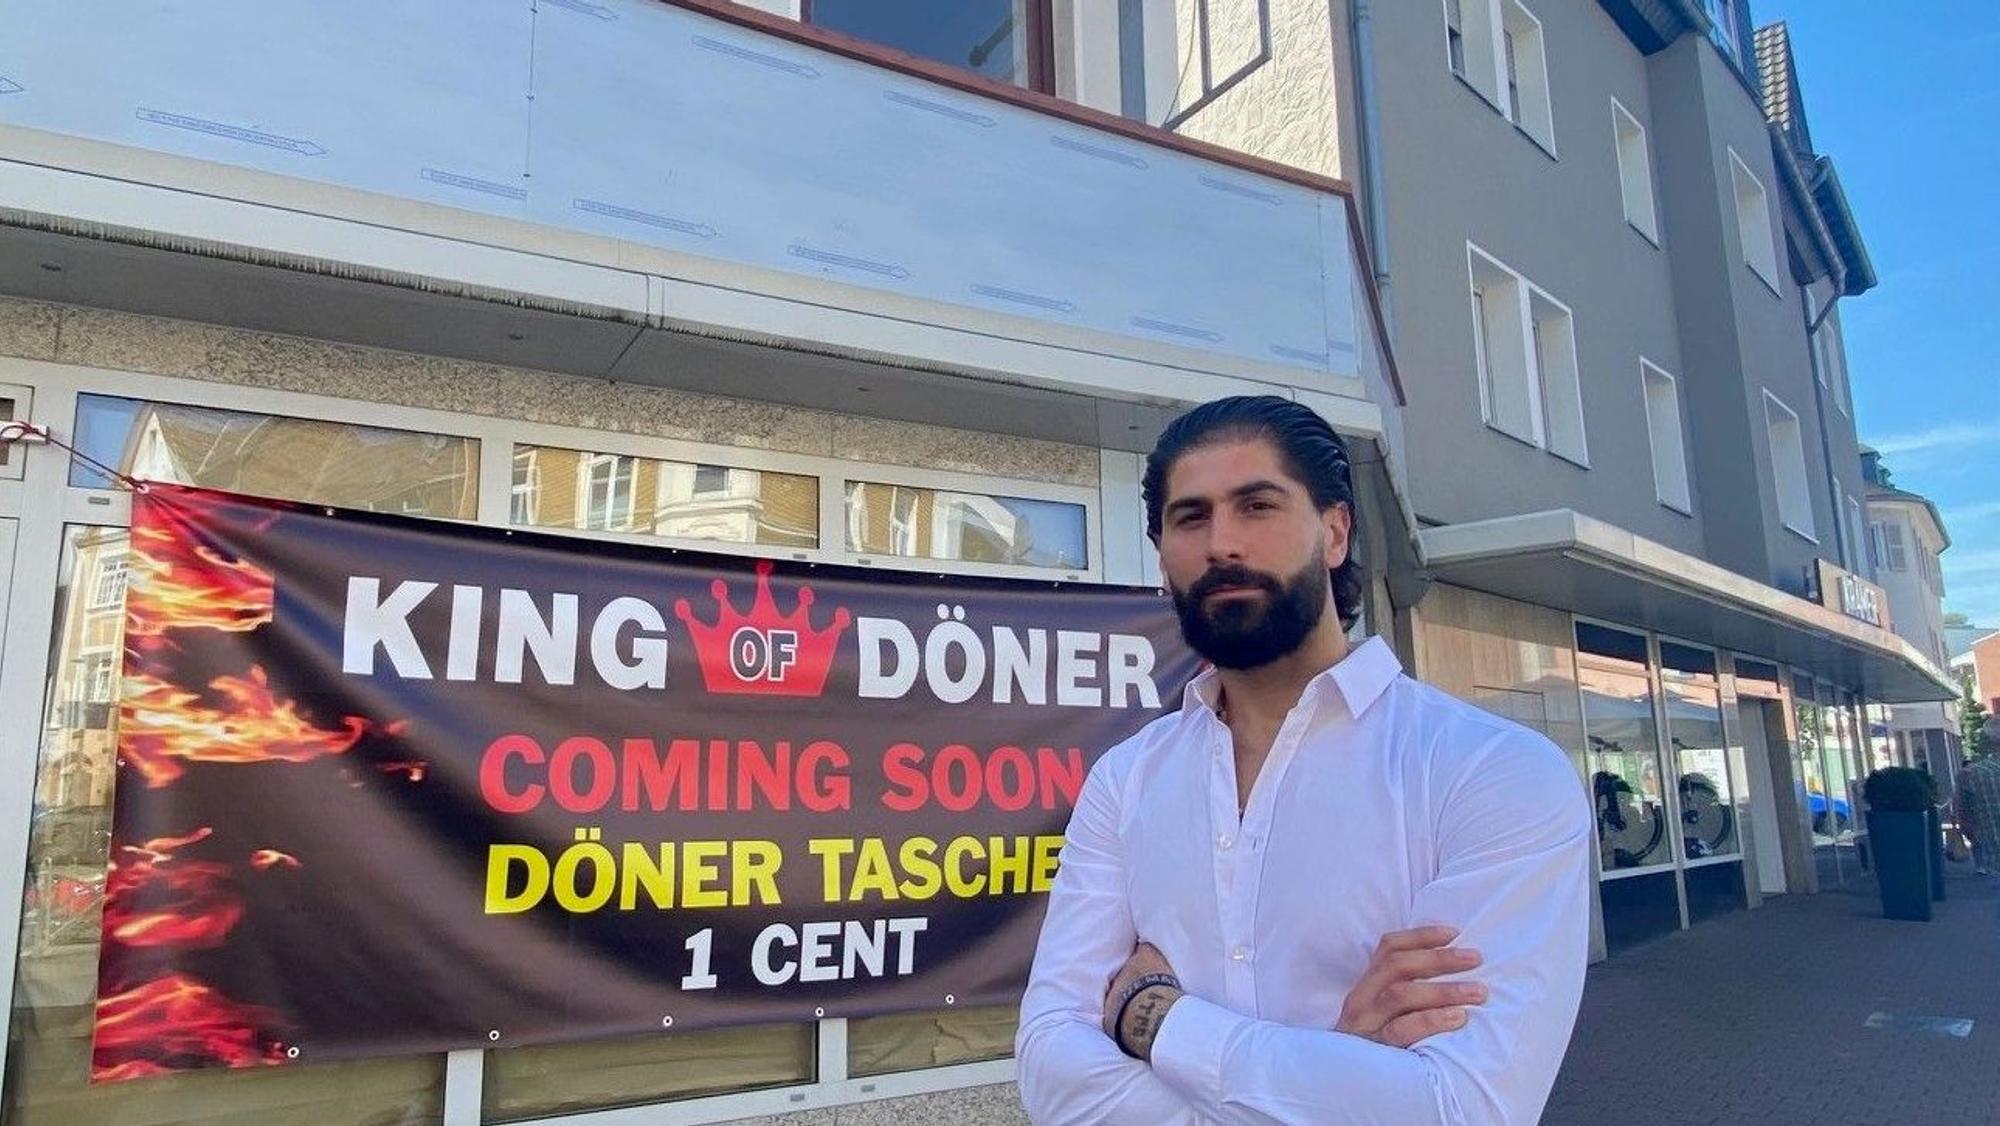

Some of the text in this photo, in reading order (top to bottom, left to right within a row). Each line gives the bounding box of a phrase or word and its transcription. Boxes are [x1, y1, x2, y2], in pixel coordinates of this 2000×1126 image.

[342, 576, 1162, 709] KING OF DÖNER
[480, 735, 1084, 812] COMING SOON
[484, 828, 1066, 914] DÖNER TASCHE
[681, 917, 928, 990] 1 CENT
